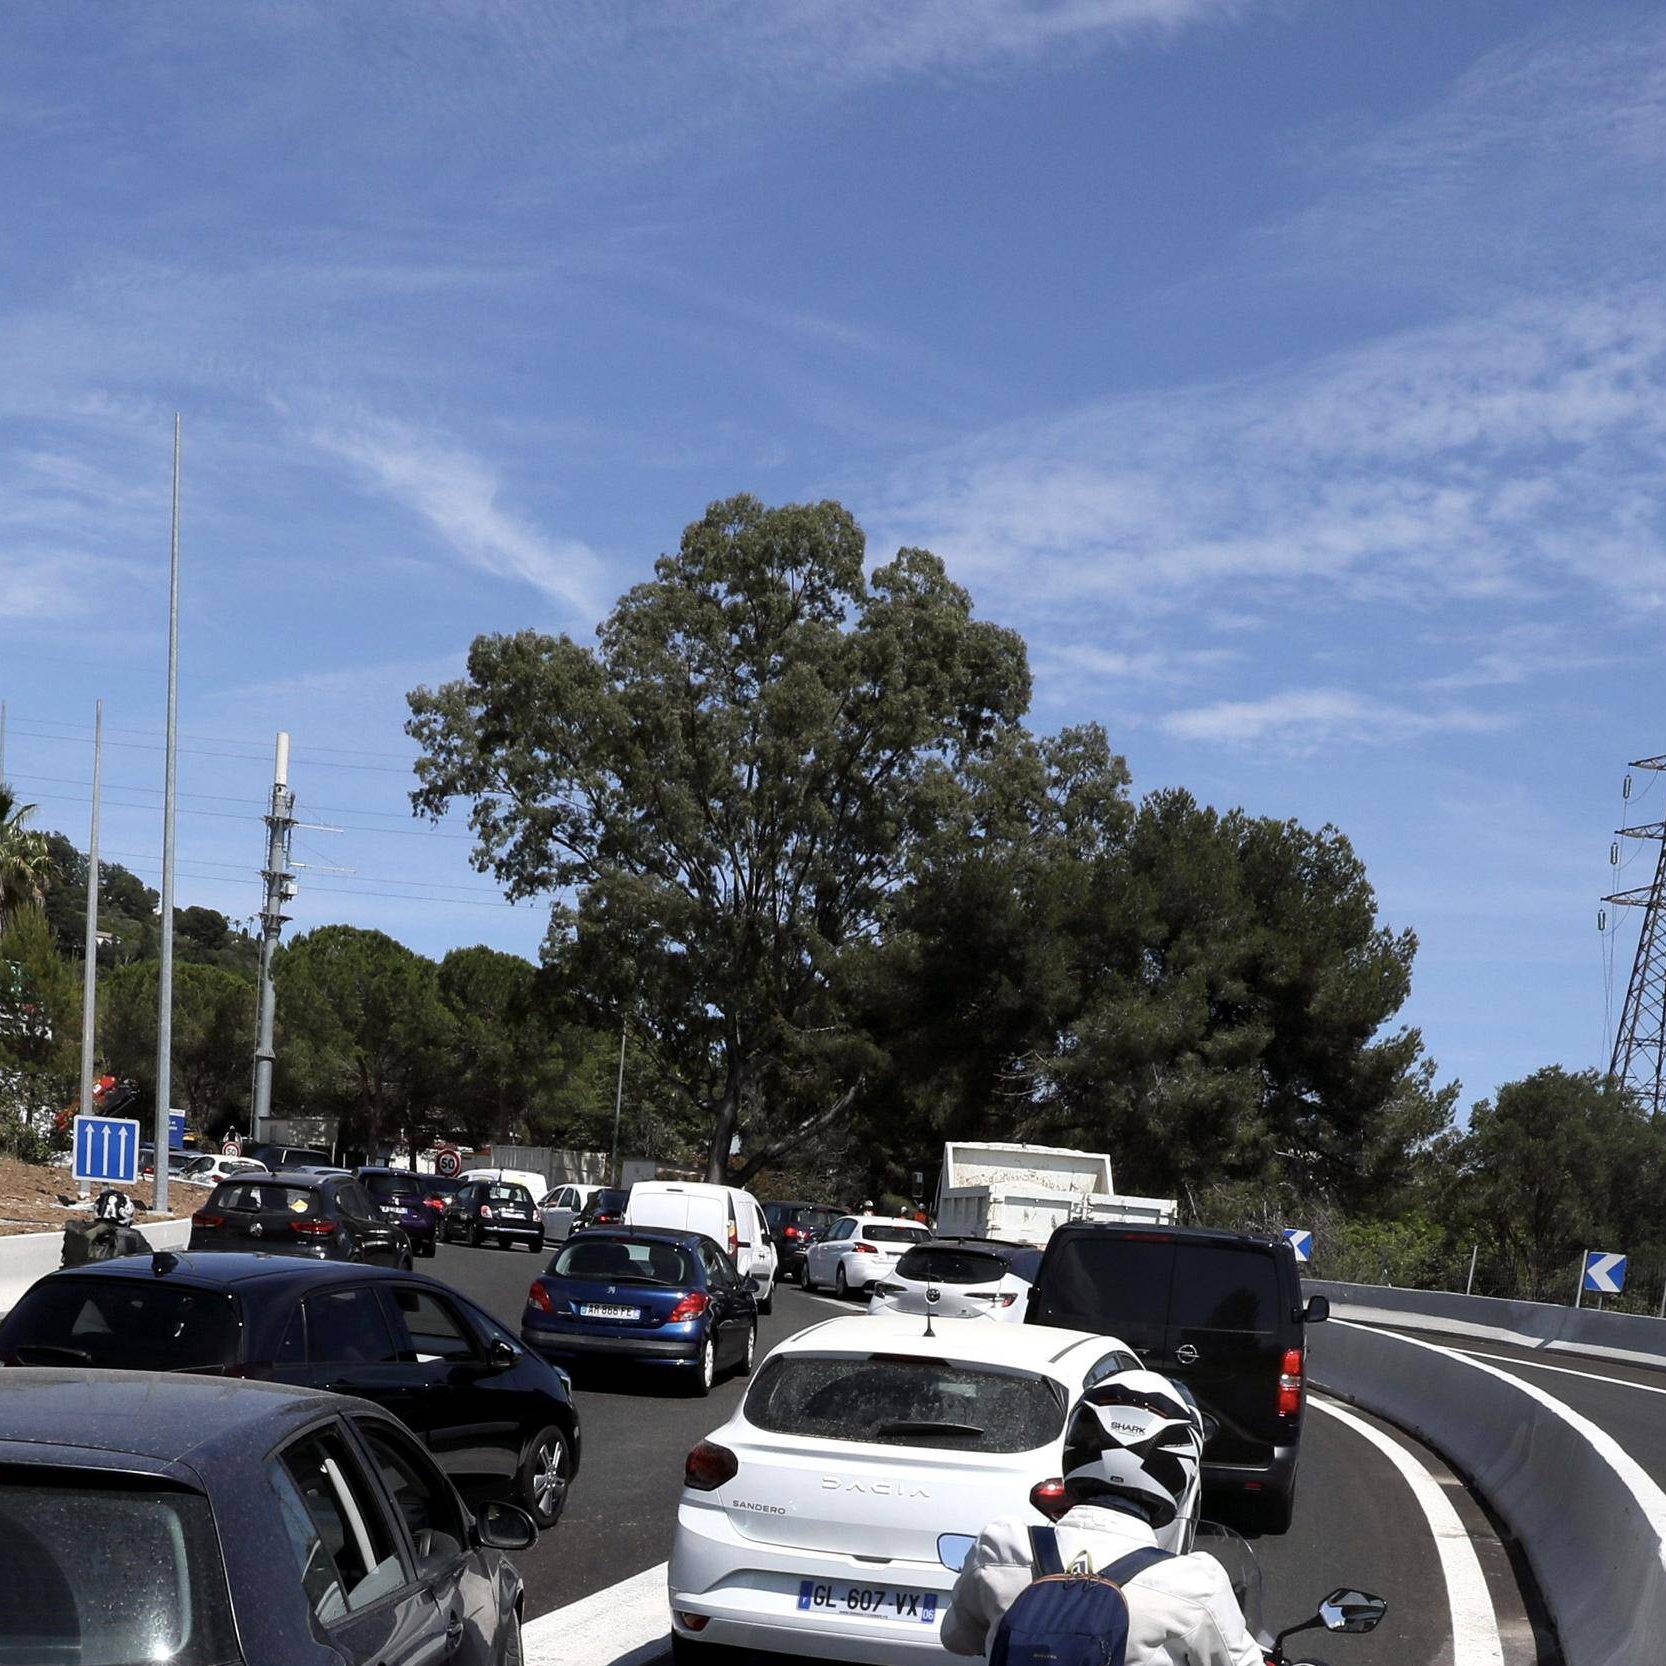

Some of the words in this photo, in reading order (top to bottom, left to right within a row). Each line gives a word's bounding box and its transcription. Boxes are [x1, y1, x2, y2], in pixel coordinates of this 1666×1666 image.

[441, 1157, 455, 1170] 50
[1111, 1421, 1146, 1434] SHARK
[733, 1499, 786, 1515] SANDERO
[922, 1608, 934, 1620] 06
